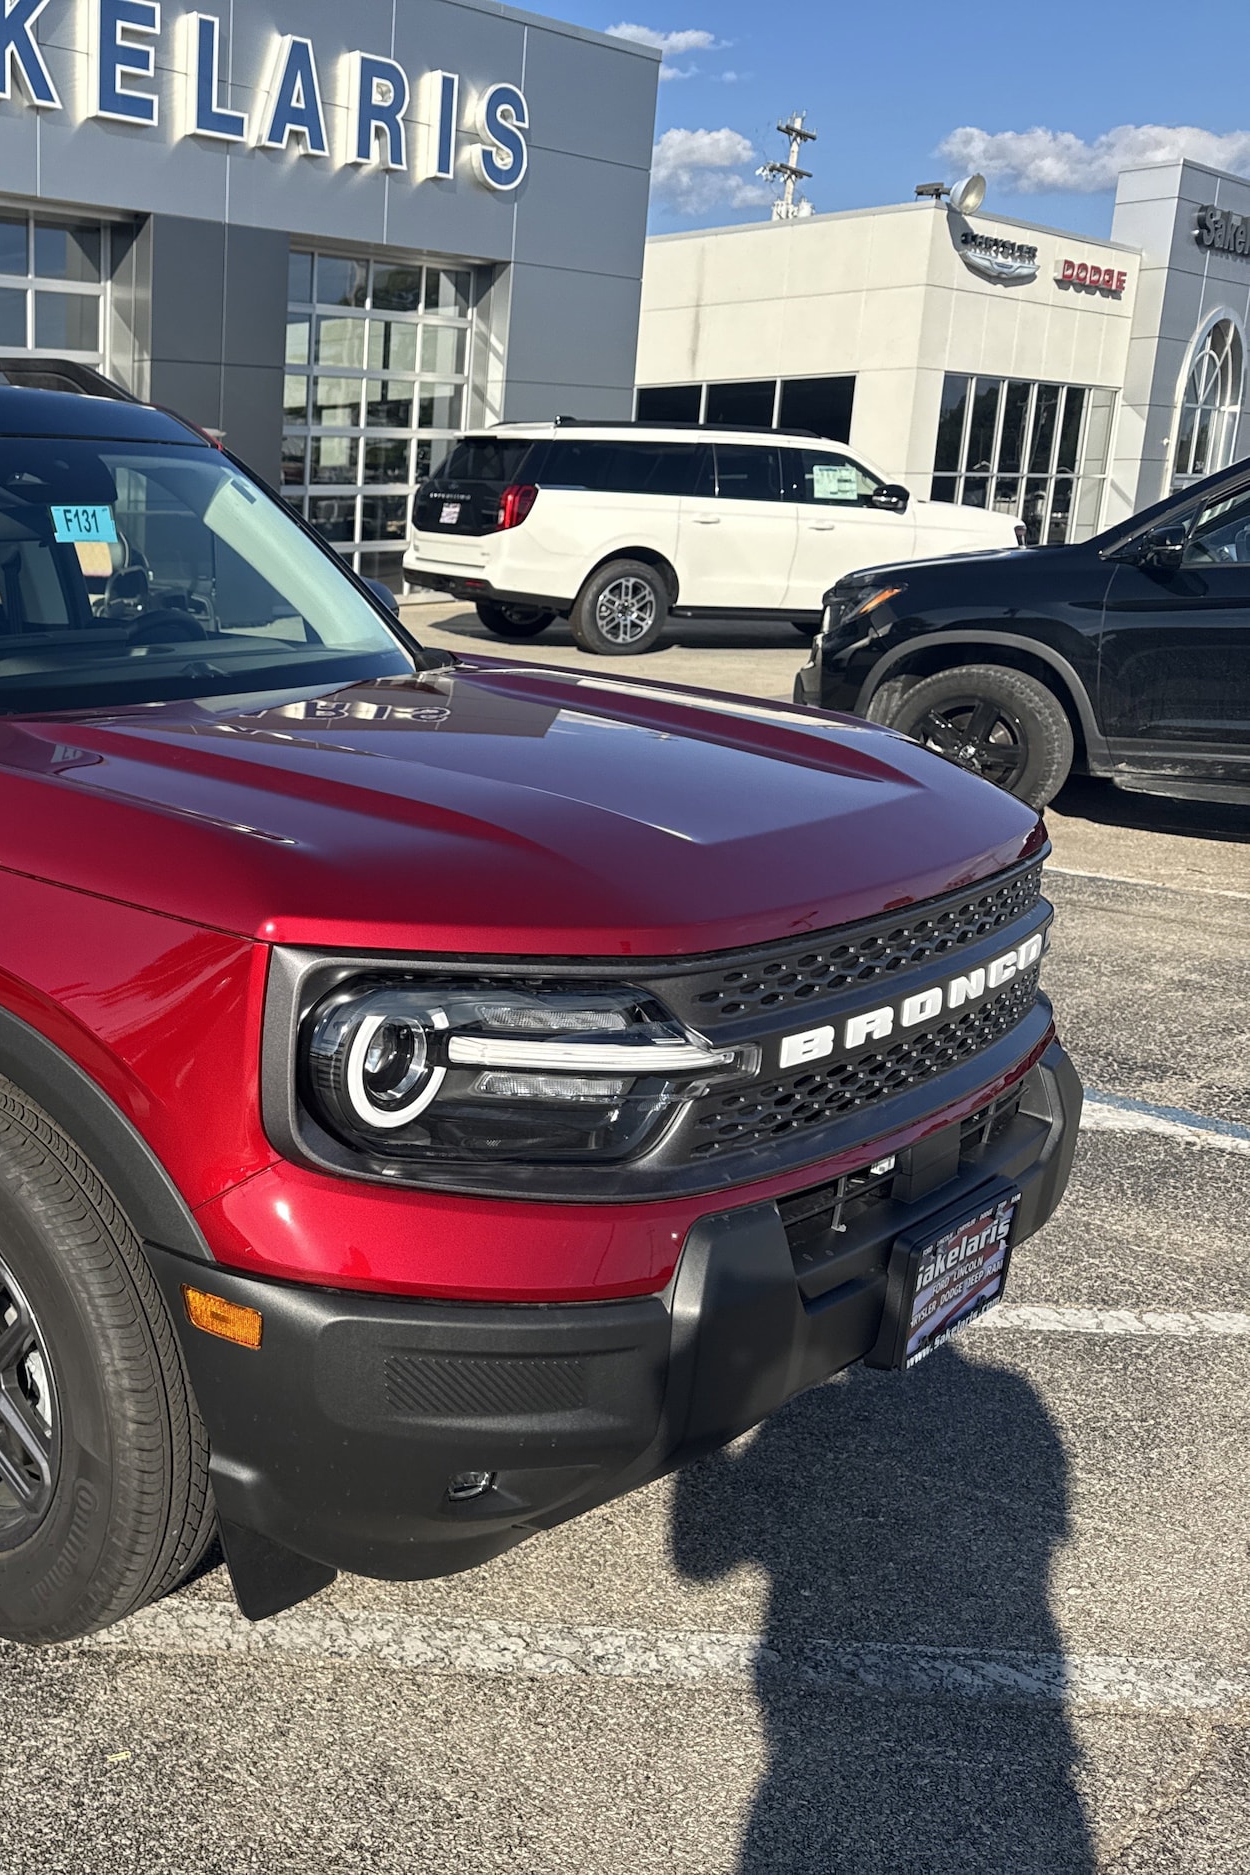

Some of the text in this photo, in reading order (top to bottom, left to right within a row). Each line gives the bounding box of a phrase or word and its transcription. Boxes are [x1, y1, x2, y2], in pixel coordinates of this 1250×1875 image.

[1062, 259, 1127, 291] DODGE
[63, 509, 99, 533] F131
[779, 933, 1043, 1069] BRONCO
[932, 1255, 984, 1295] FORD LINCOLN
[940, 1282, 964, 1306] DODGE
[967, 1270, 985, 1288] JEEP
